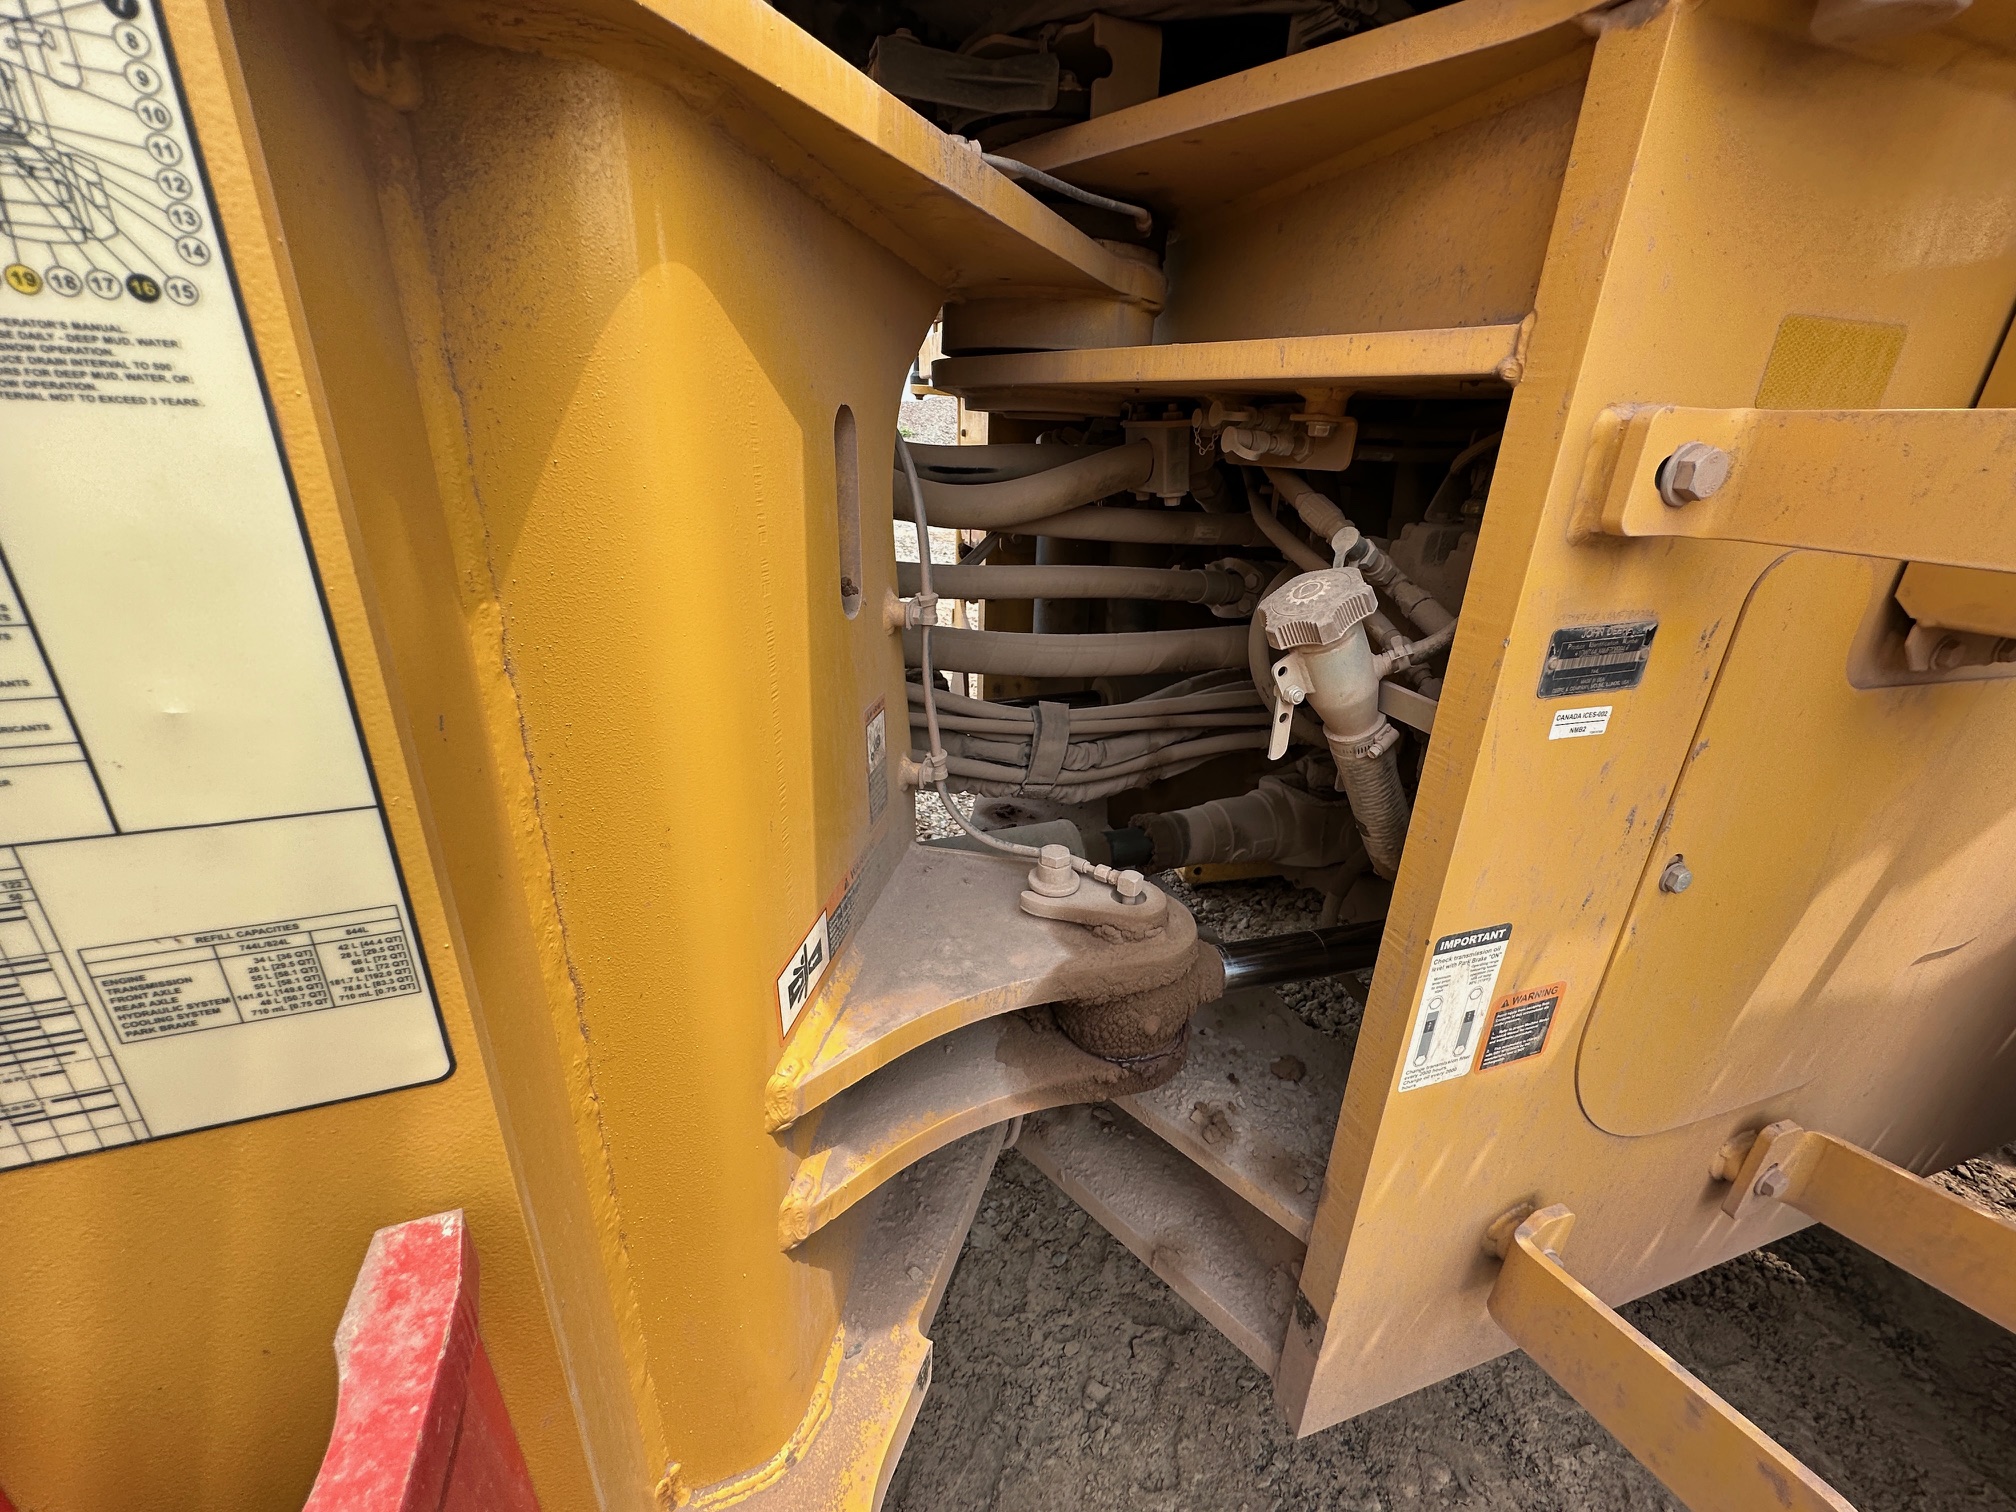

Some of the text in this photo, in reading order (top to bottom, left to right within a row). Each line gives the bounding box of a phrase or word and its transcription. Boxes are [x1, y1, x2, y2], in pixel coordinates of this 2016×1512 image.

[137, 70, 149, 87] 9
[143, 106, 168, 124] 10
[154, 142, 176, 159] 11
[163, 176, 187, 194] 12
[173, 209, 197, 226] 13
[181, 243, 206, 260] 14
[12, 270, 36, 288] 19
[53, 273, 75, 291] 18
[92, 276, 115, 294] 17
[132, 279, 156, 297] 16
[171, 283, 194, 301] 15
[17, 331, 54, 342] DAILY
[65, 334, 99, 344] DEEP
[27, 356, 67, 367] DRAIN
[70, 358, 130, 371] INTERVAL
[133, 361, 150, 372] TO
[24, 368, 51, 379] FOR
[54, 369, 87, 380] DEEP
[49, 393, 75, 403] NOT
[78, 394, 96, 404] TO
[99, 395, 148, 407] EXCEED
[1581, 628, 1604, 639] JOHN
[1556, 712, 1582, 722] CANADA
[194, 923, 300, 945] REFILL CAPACITIES
[345, 926, 369, 937] 844L
[1440, 929, 1506, 950] IMPORTANT
[239, 938, 291, 952] 744L/824L
[337, 943, 350, 951] 42
[384, 935, 404, 946] QT]
[387, 943, 406, 953] QT]
[294, 949, 314, 959] QT]
[297, 957, 317, 967] QT]
[389, 952, 408, 961] QT]
[1434, 957, 1452, 966] Check
[1454, 947, 1492, 960] transmission
[392, 959, 410, 969] QT]
[394, 967, 412, 977] QT]
[1432, 964, 1445, 972] level
[1458, 959, 1470, 967] Park
[1472, 956, 1488, 964] Brake
[101, 974, 147, 987] ENGINE
[250, 973, 263, 982] 55
[300, 965, 320, 975] QT]
[254, 982, 267, 990] 55
[303, 973, 322, 983] QT]
[396, 975, 414, 985] QT]
[105, 976, 194, 995] TRANSMISSION
[305, 982, 324, 992] QT]
[358, 989, 374, 998] mL
[398, 983, 417, 993] QT]
[109, 987, 183, 1005] FRONT AXLE
[308, 990, 328, 1000] QT]
[1512, 986, 1559, 1005] WARNING
[113, 997, 179, 1013] REAR AXLE
[117, 997, 231, 1021] HYDRAULIC SYSTEM
[272, 1004, 288, 1013] mL
[121, 1007, 221, 1029] COOLING SYSTEM
[124, 1019, 198, 1038] PARK BRAKE
[1406, 1067, 1425, 1075] Change
[1426, 1058, 1459, 1070] transmission
[1403, 1077, 1423, 1085] Change
[1431, 1071, 1444, 1079] every
